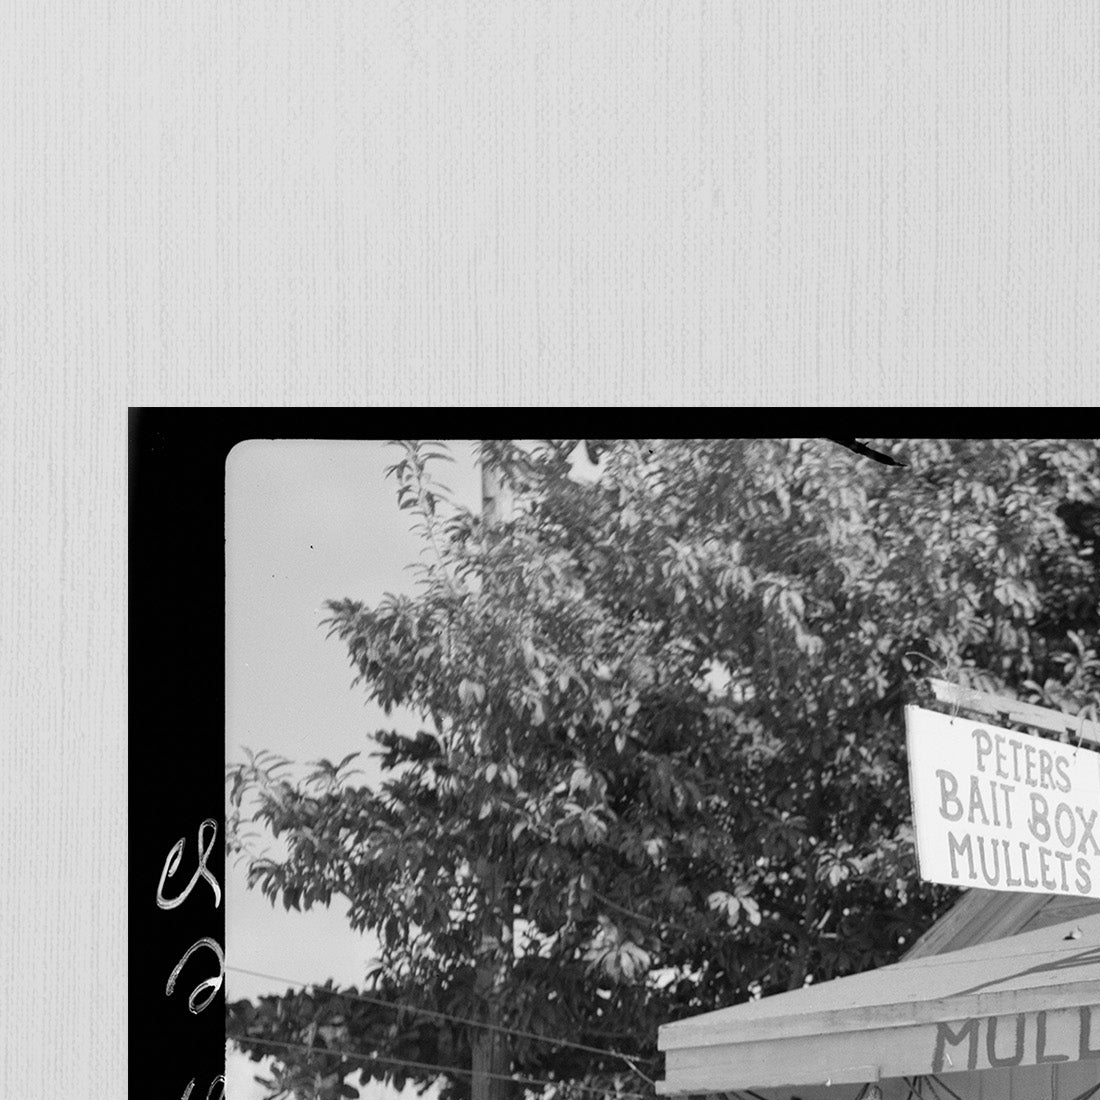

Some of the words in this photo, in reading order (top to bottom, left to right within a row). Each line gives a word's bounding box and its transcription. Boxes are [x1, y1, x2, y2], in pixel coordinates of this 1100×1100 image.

[971, 728, 1072, 793] PETERS
[935, 768, 1016, 829] BAIT
[947, 830, 1093, 895] MULLETS
